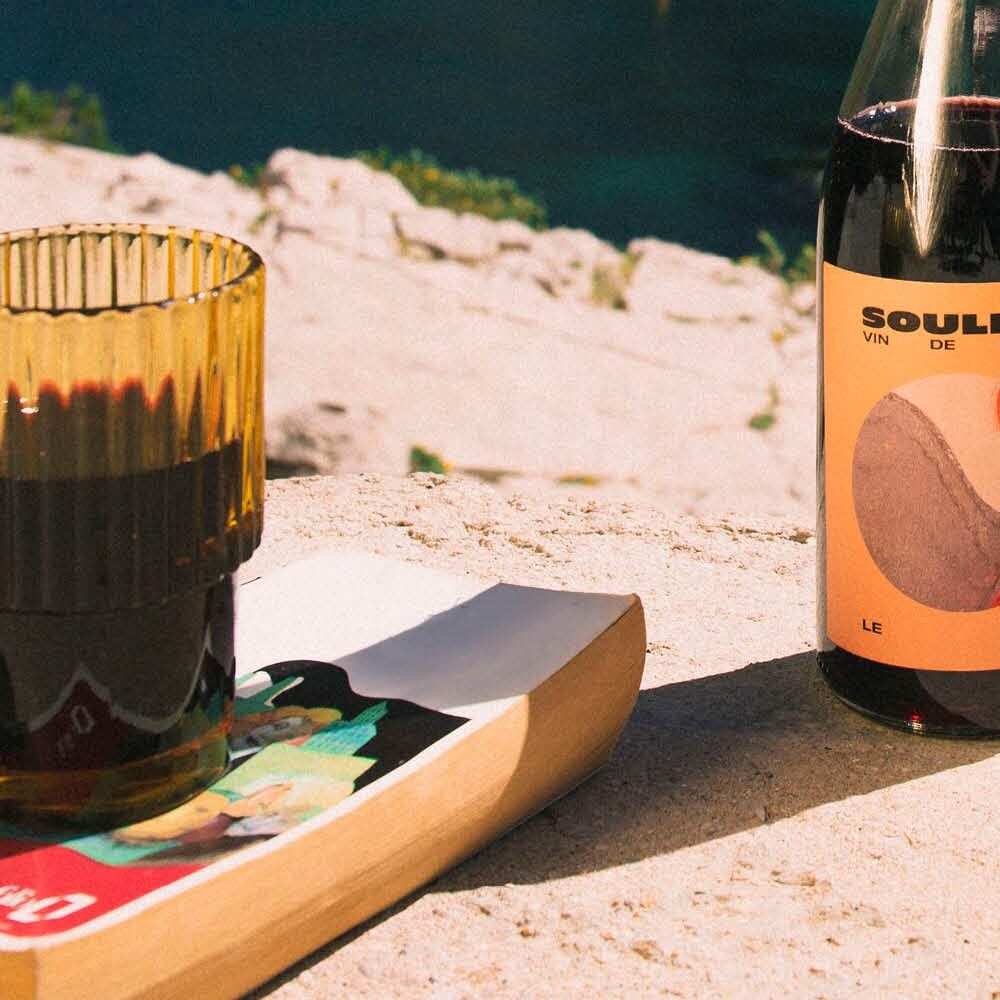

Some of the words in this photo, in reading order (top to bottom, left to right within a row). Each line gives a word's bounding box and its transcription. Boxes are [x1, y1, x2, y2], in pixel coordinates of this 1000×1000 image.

[862, 330, 889, 346] VIN
[930, 338, 956, 351] DE
[862, 618, 883, 635] LE
